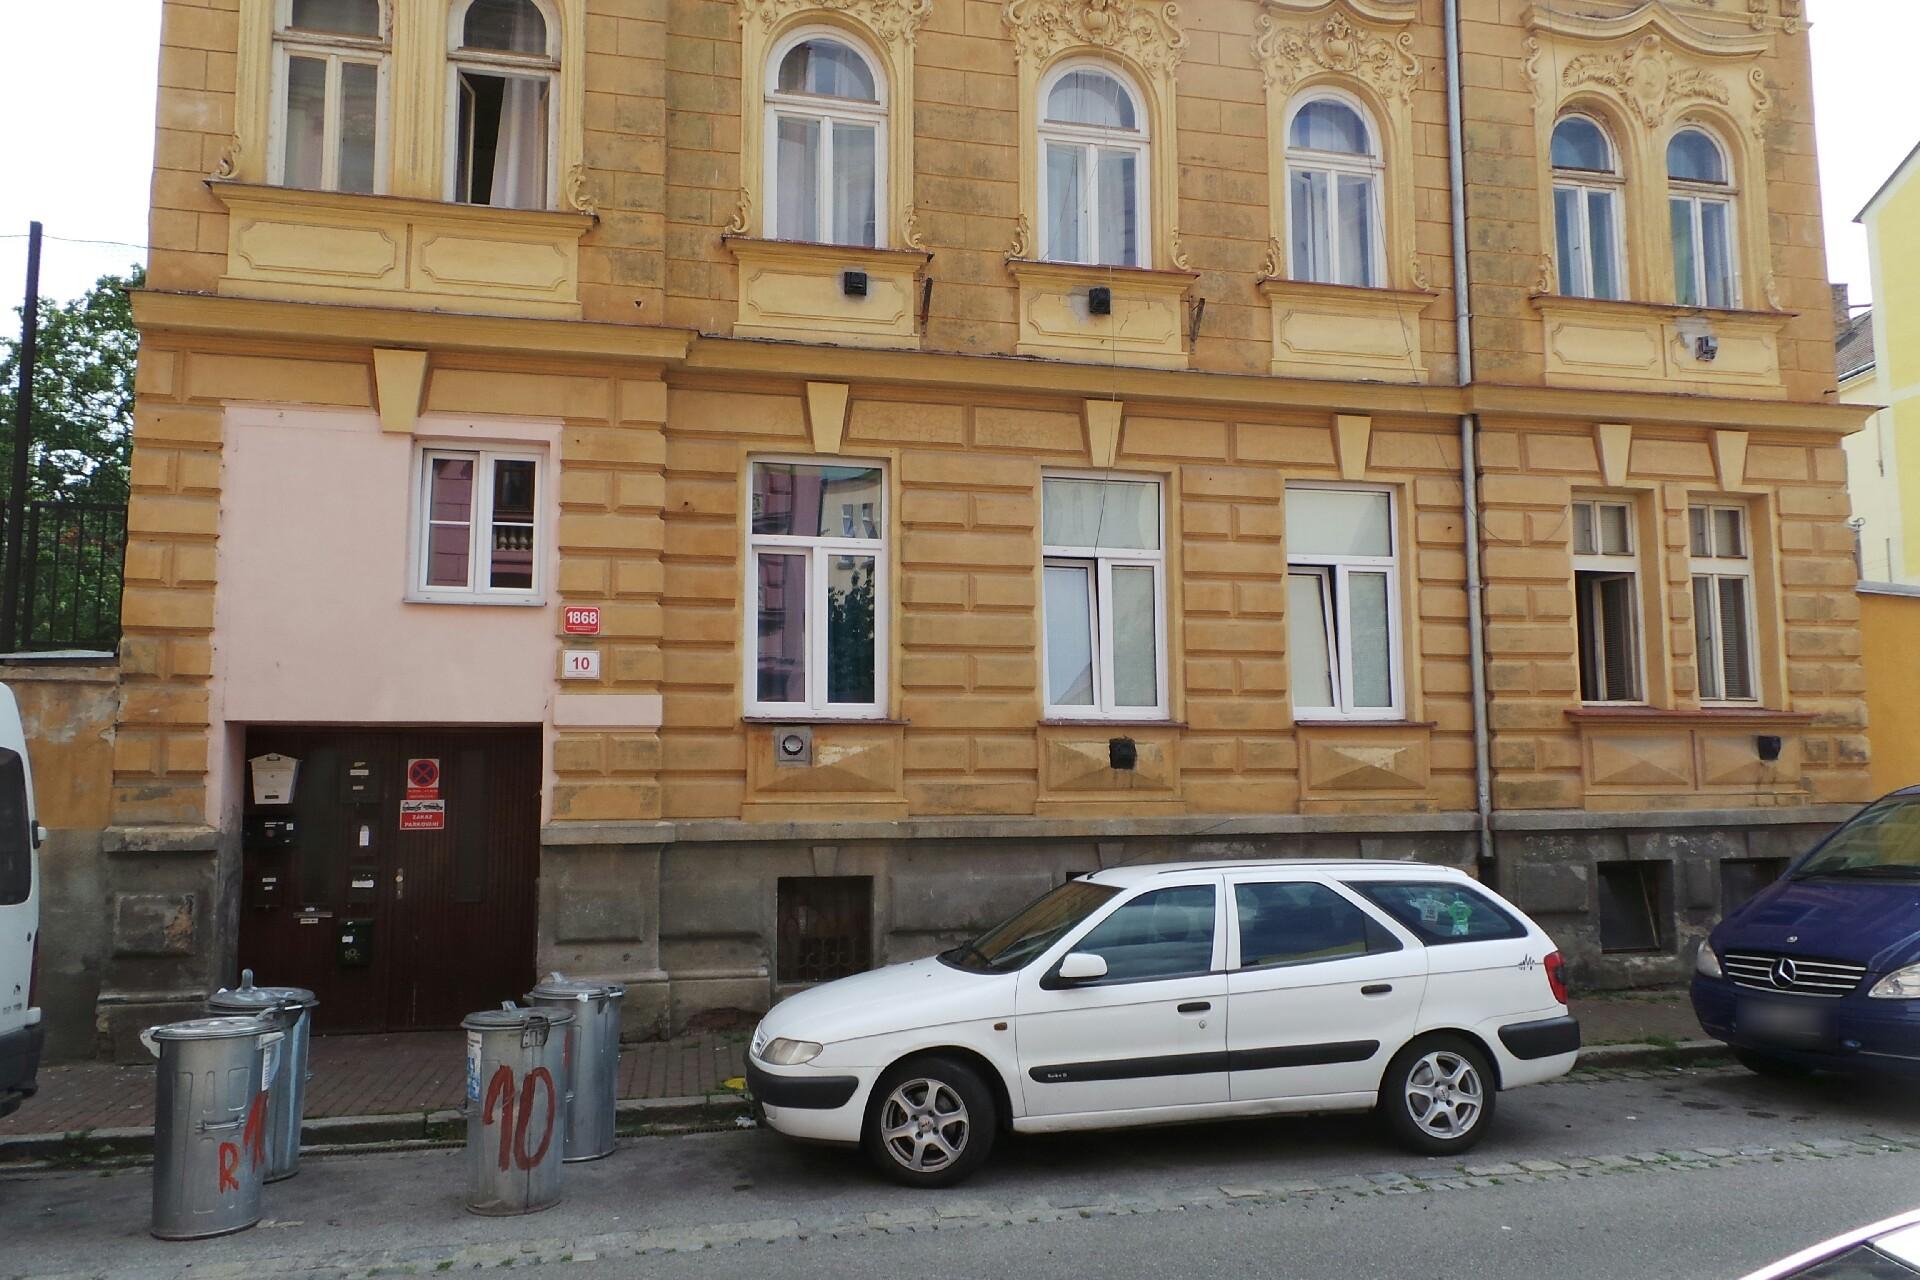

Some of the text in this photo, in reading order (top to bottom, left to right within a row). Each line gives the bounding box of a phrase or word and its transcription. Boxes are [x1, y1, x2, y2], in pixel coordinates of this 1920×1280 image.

[567, 611, 597, 624] 1868
[572, 656, 590, 671] 10
[482, 1064, 556, 1173] 10
[218, 1142, 240, 1195] R
